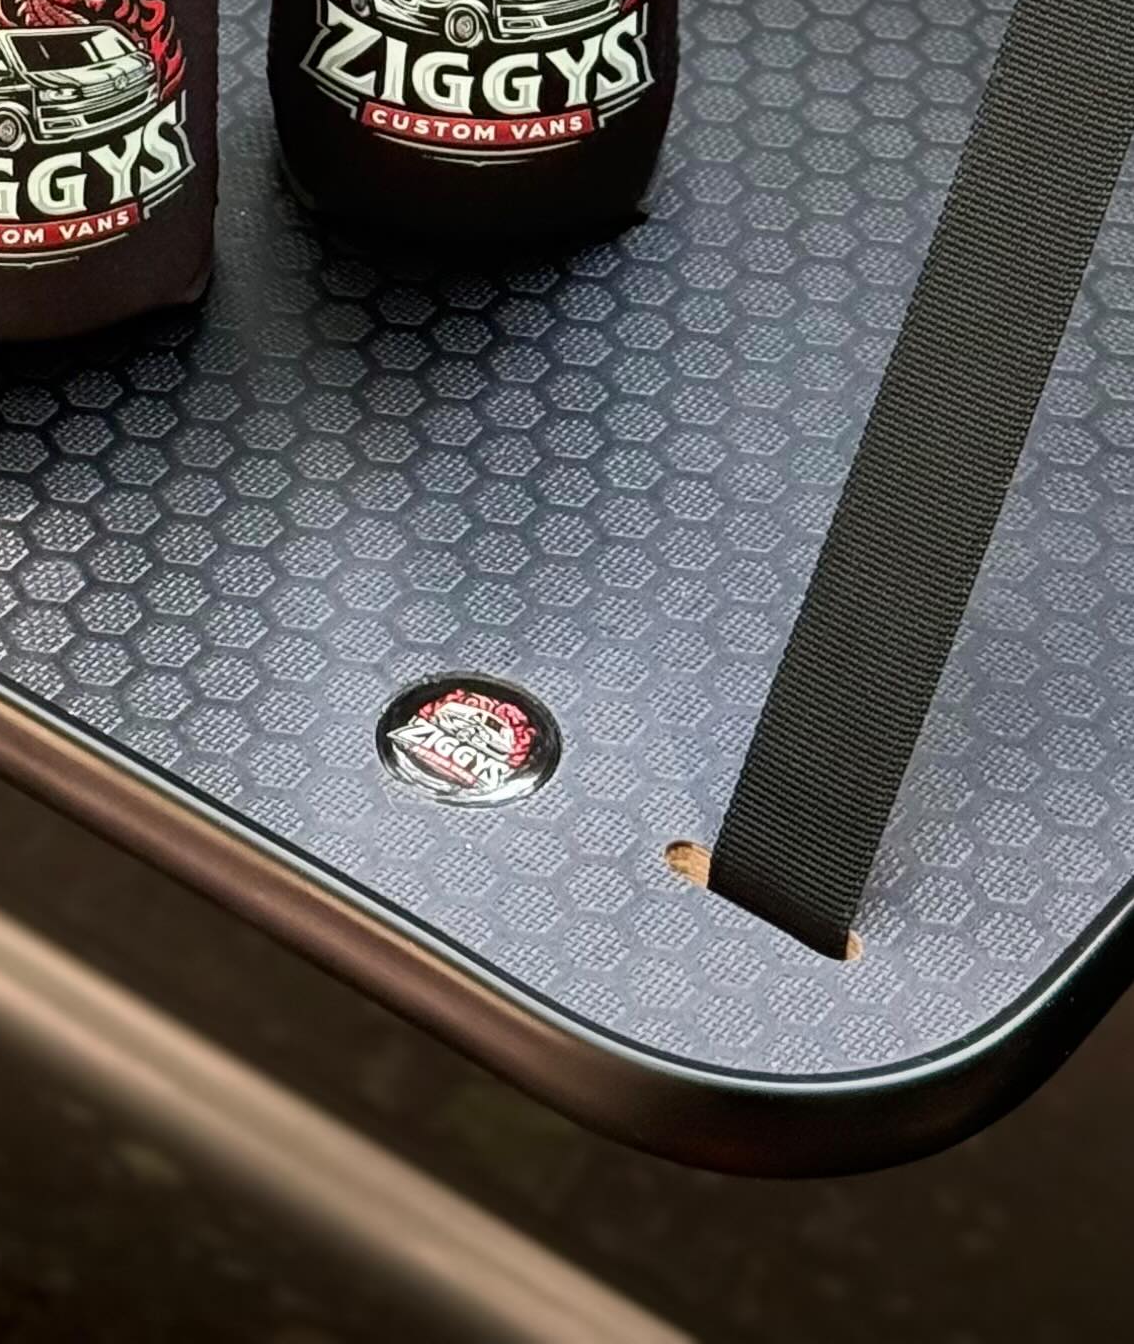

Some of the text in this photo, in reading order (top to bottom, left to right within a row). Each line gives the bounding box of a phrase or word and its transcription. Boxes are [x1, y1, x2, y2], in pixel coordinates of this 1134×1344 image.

[317, 0, 640, 116] ZIGGYS
[371, 109, 583, 141] CUSTOM VANS
[58, 210, 130, 241] VANS
[397, 718, 510, 790] ZIGGYS
